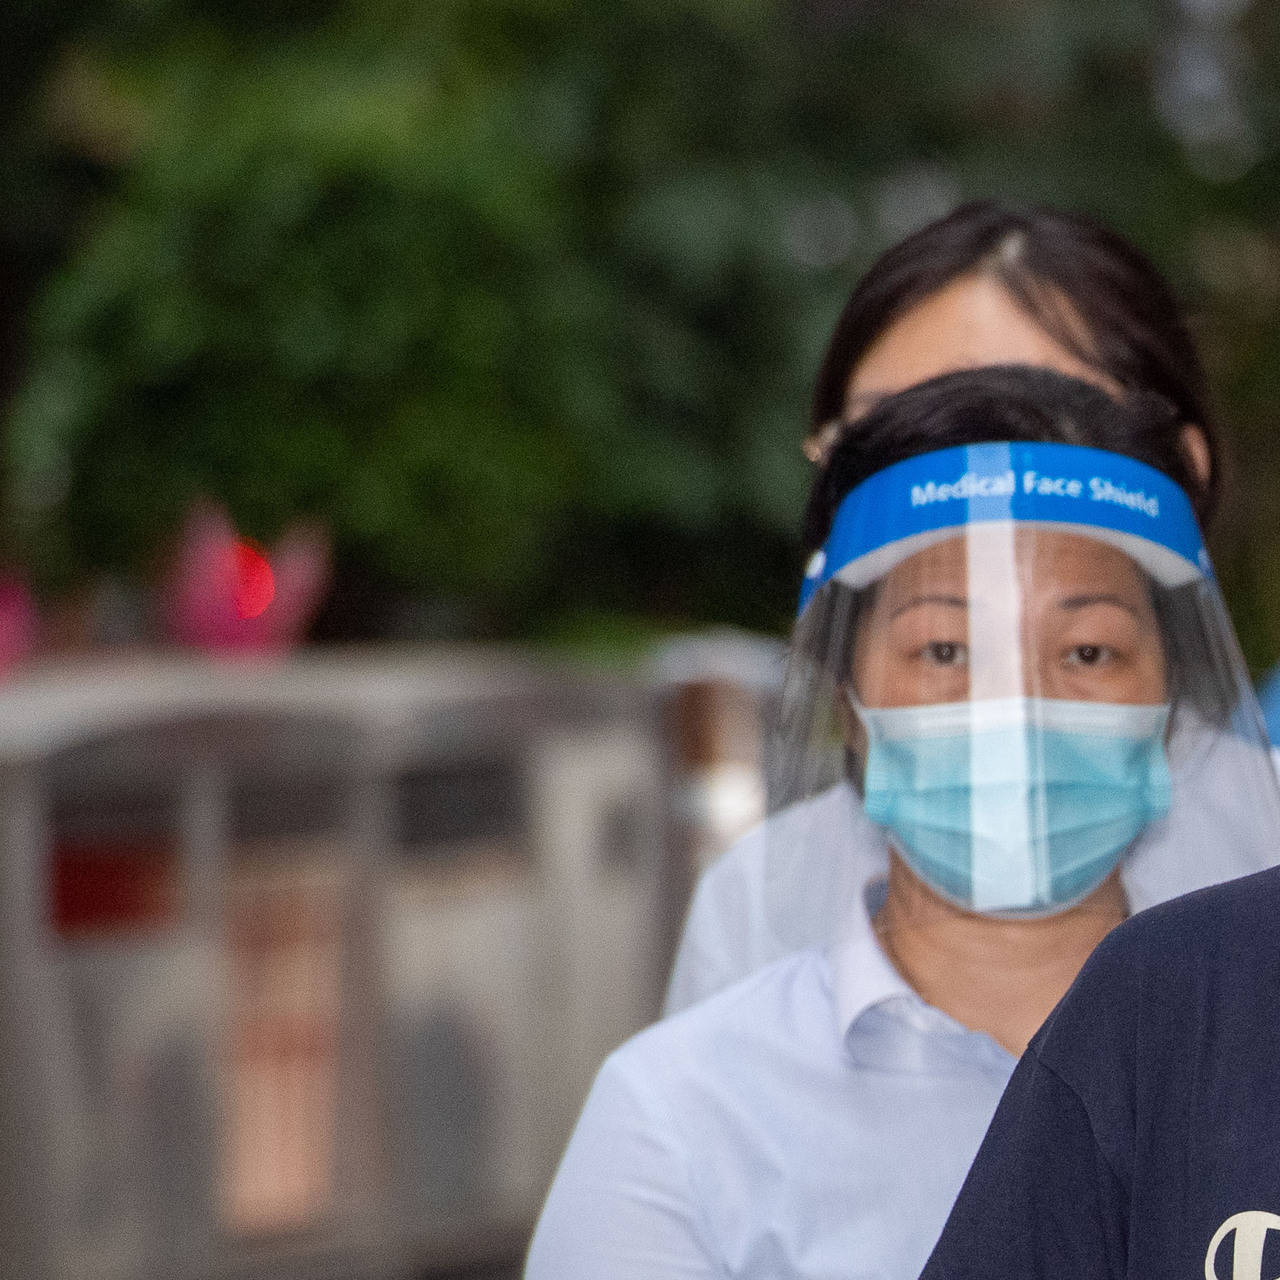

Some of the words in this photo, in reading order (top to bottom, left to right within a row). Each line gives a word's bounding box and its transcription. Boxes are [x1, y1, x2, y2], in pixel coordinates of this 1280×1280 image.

[911, 470, 1015, 506] Medical
[1023, 470, 1083, 498] Face
[1089, 477, 1159, 517] Shield
